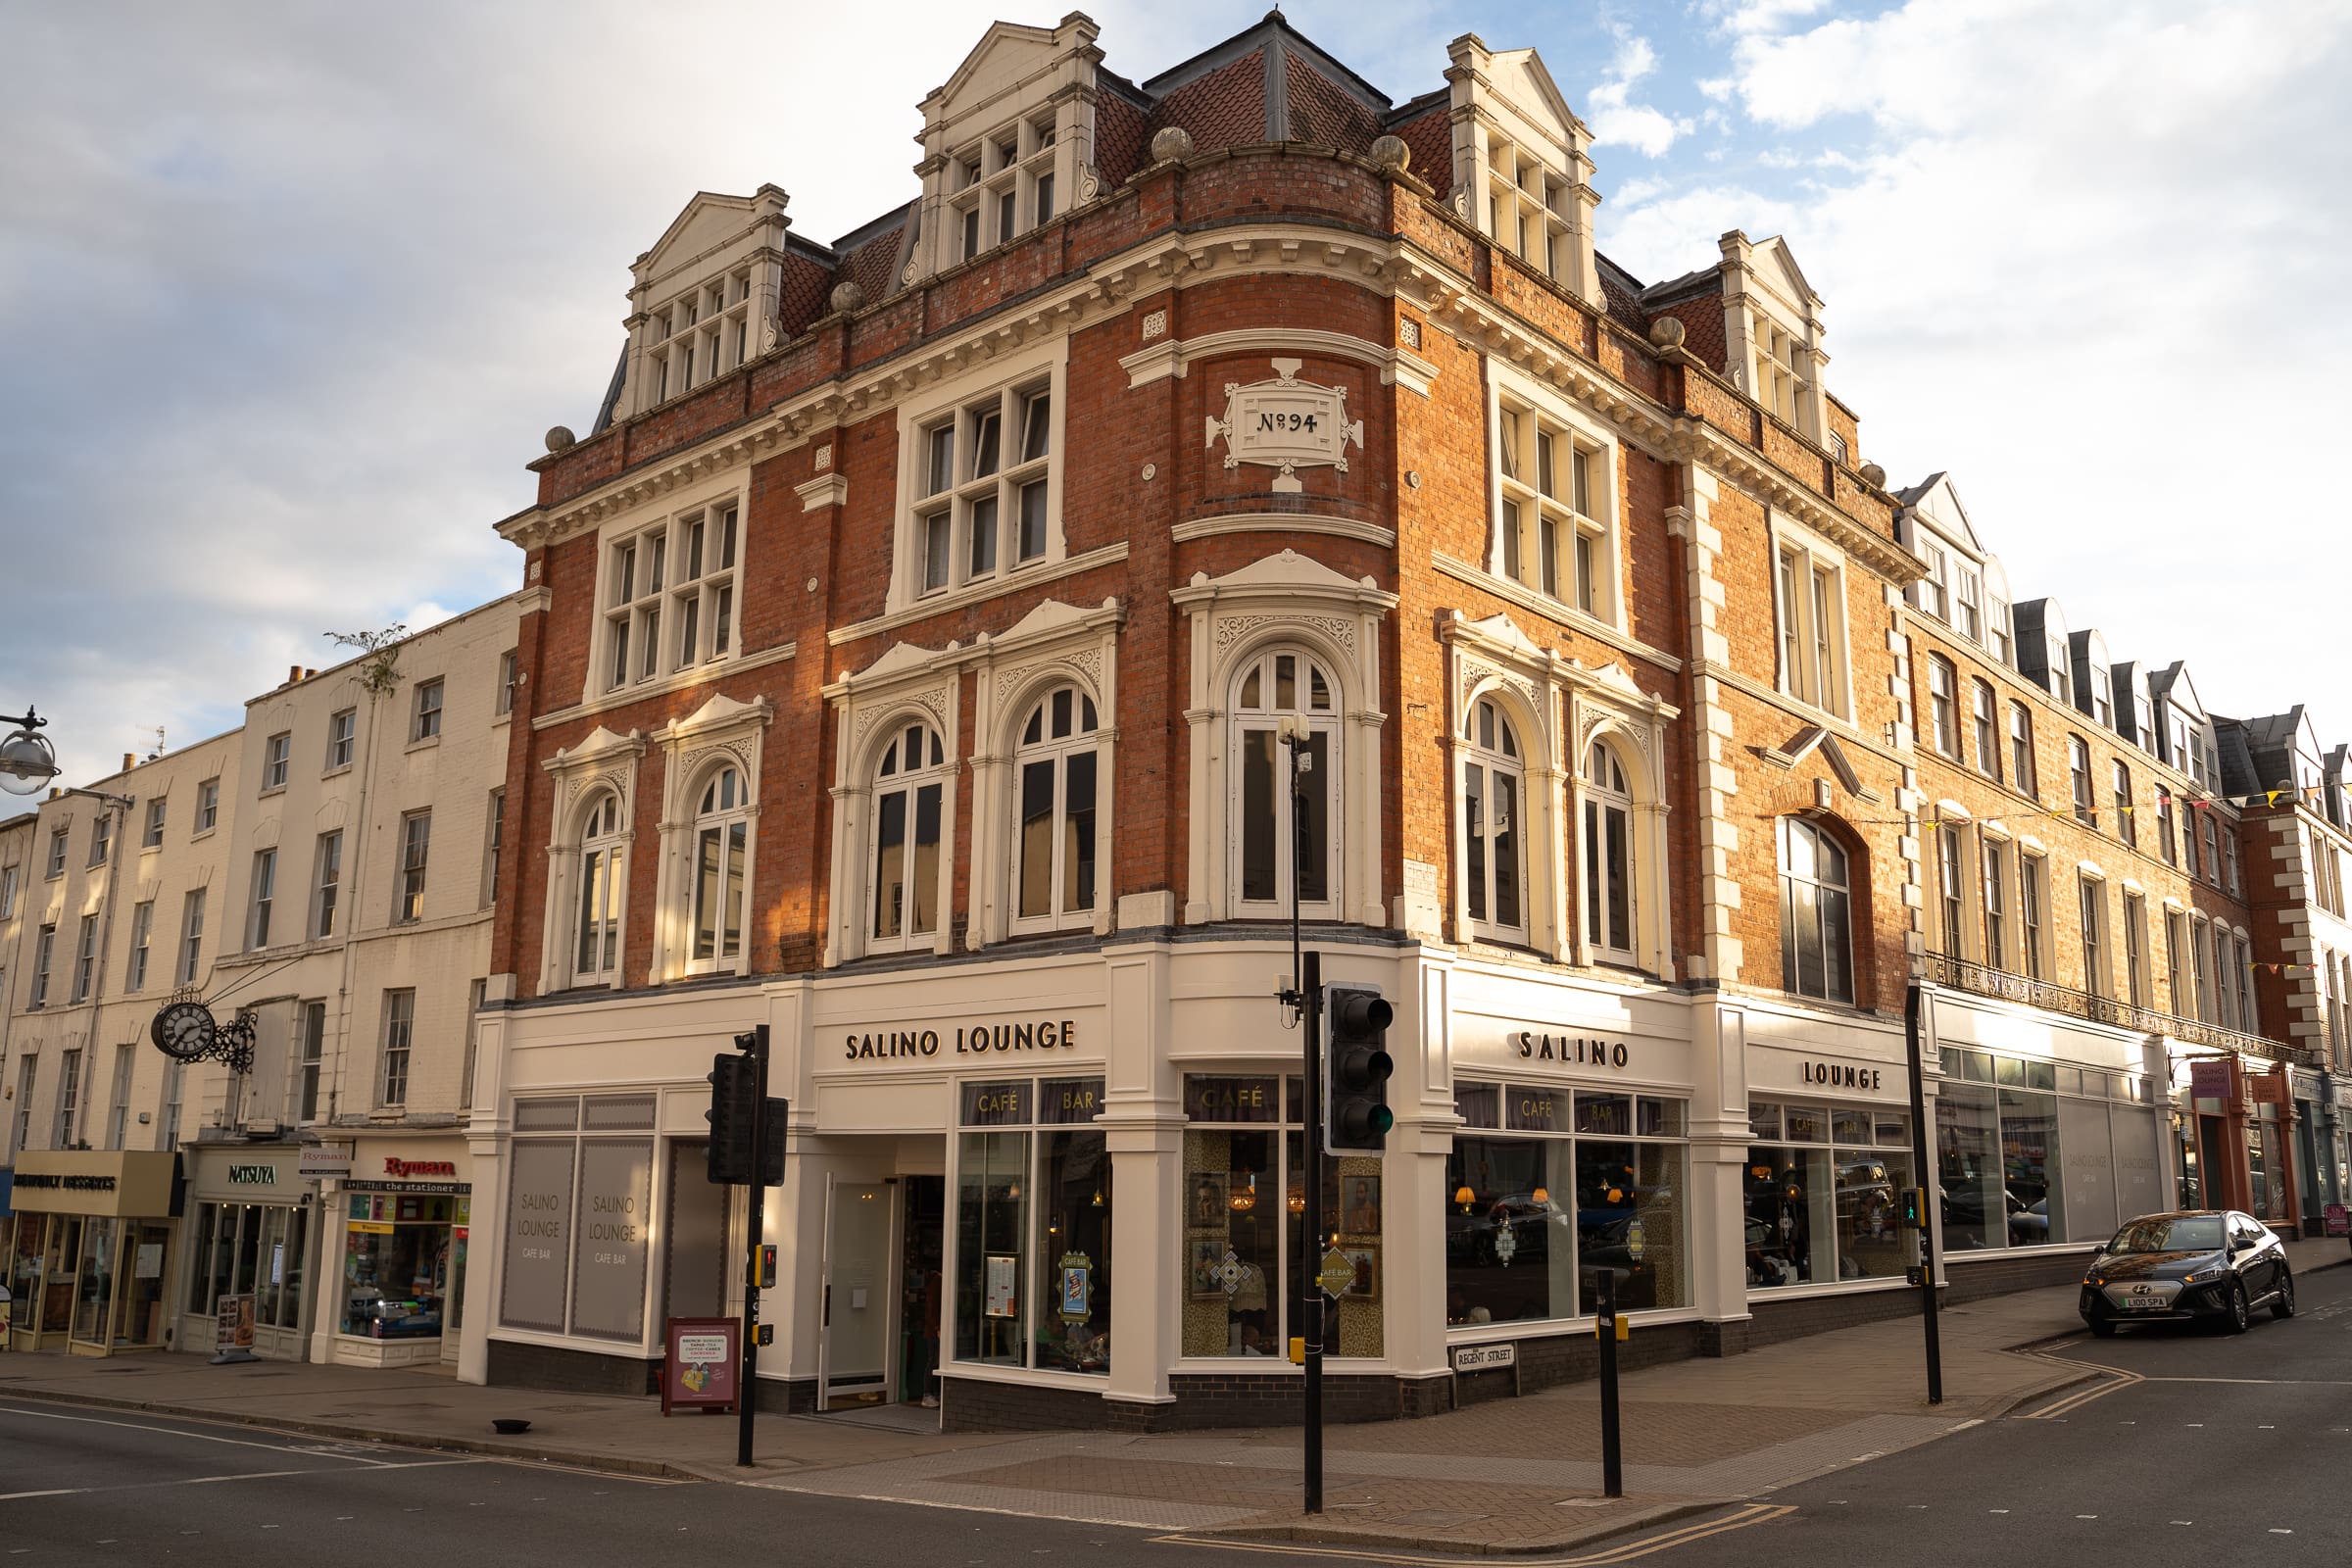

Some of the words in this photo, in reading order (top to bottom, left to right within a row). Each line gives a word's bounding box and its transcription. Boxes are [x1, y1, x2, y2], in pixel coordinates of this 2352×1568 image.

[846, 1030, 940, 1060] SALINO
[956, 1020, 1075, 1054] LOUNGE
[1518, 1032, 1628, 1068] SALINO
[1803, 1061, 1881, 1090] LOUNGE
[978, 1092, 1018, 1112] CAFÉ
[1062, 1092, 1095, 1110] BAR
[1200, 1086, 1263, 1108] CAFÉ
[1522, 1098, 1552, 1117] CAFÉ
[1592, 1104, 1613, 1121] BAR
[303, 1152, 348, 1161] Ryman
[228, 1164, 275, 1184] NATSUYA
[384, 1157, 456, 1177] Ryman
[521, 1194, 559, 1211] SALINO
[593, 1196, 635, 1214] SALINO
[517, 1220, 560, 1237] LOUNGE
[589, 1223, 636, 1242] LOUNGE
[613, 1253, 626, 1264] BAR
[1458, 1352, 1485, 1365] REGENT
[1488, 1349, 1511, 1361] STREET
